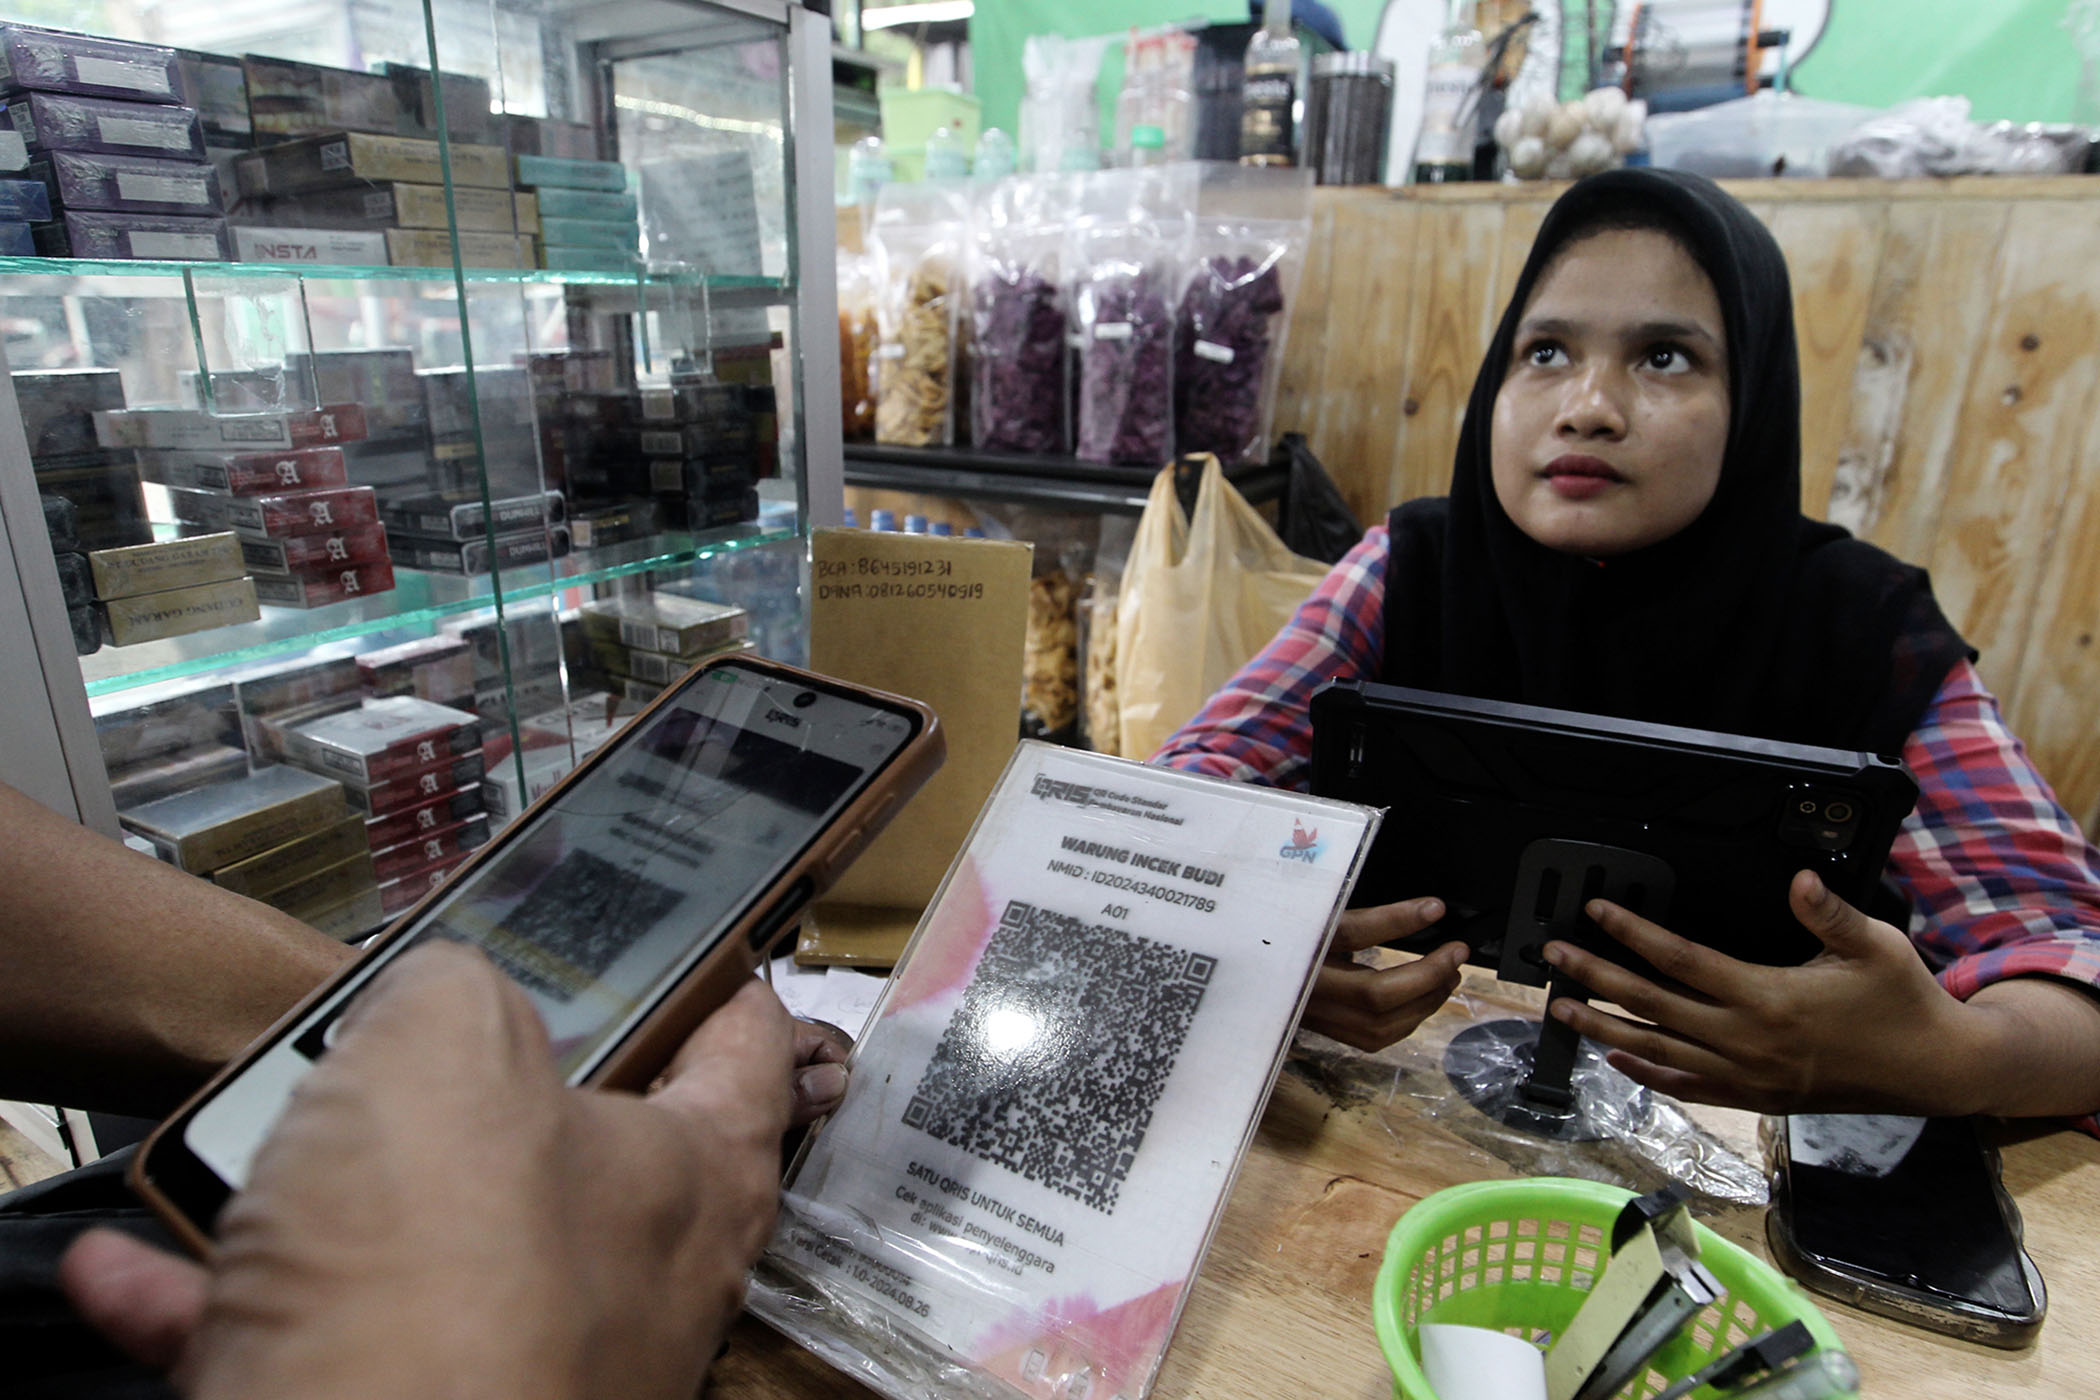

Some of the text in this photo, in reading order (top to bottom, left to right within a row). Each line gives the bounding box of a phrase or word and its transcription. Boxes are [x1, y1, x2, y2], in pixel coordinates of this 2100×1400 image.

[1142, 810, 1185, 827] Nasional
[1060, 835, 1226, 888] WARUNG INCEK BUDI
[1101, 903, 1131, 921] A01
[895, 1185, 1056, 1275] Cek aplikasi penyelenggara
[906, 1161, 1066, 1247] SATU QRIS UNTUK SEMUA
